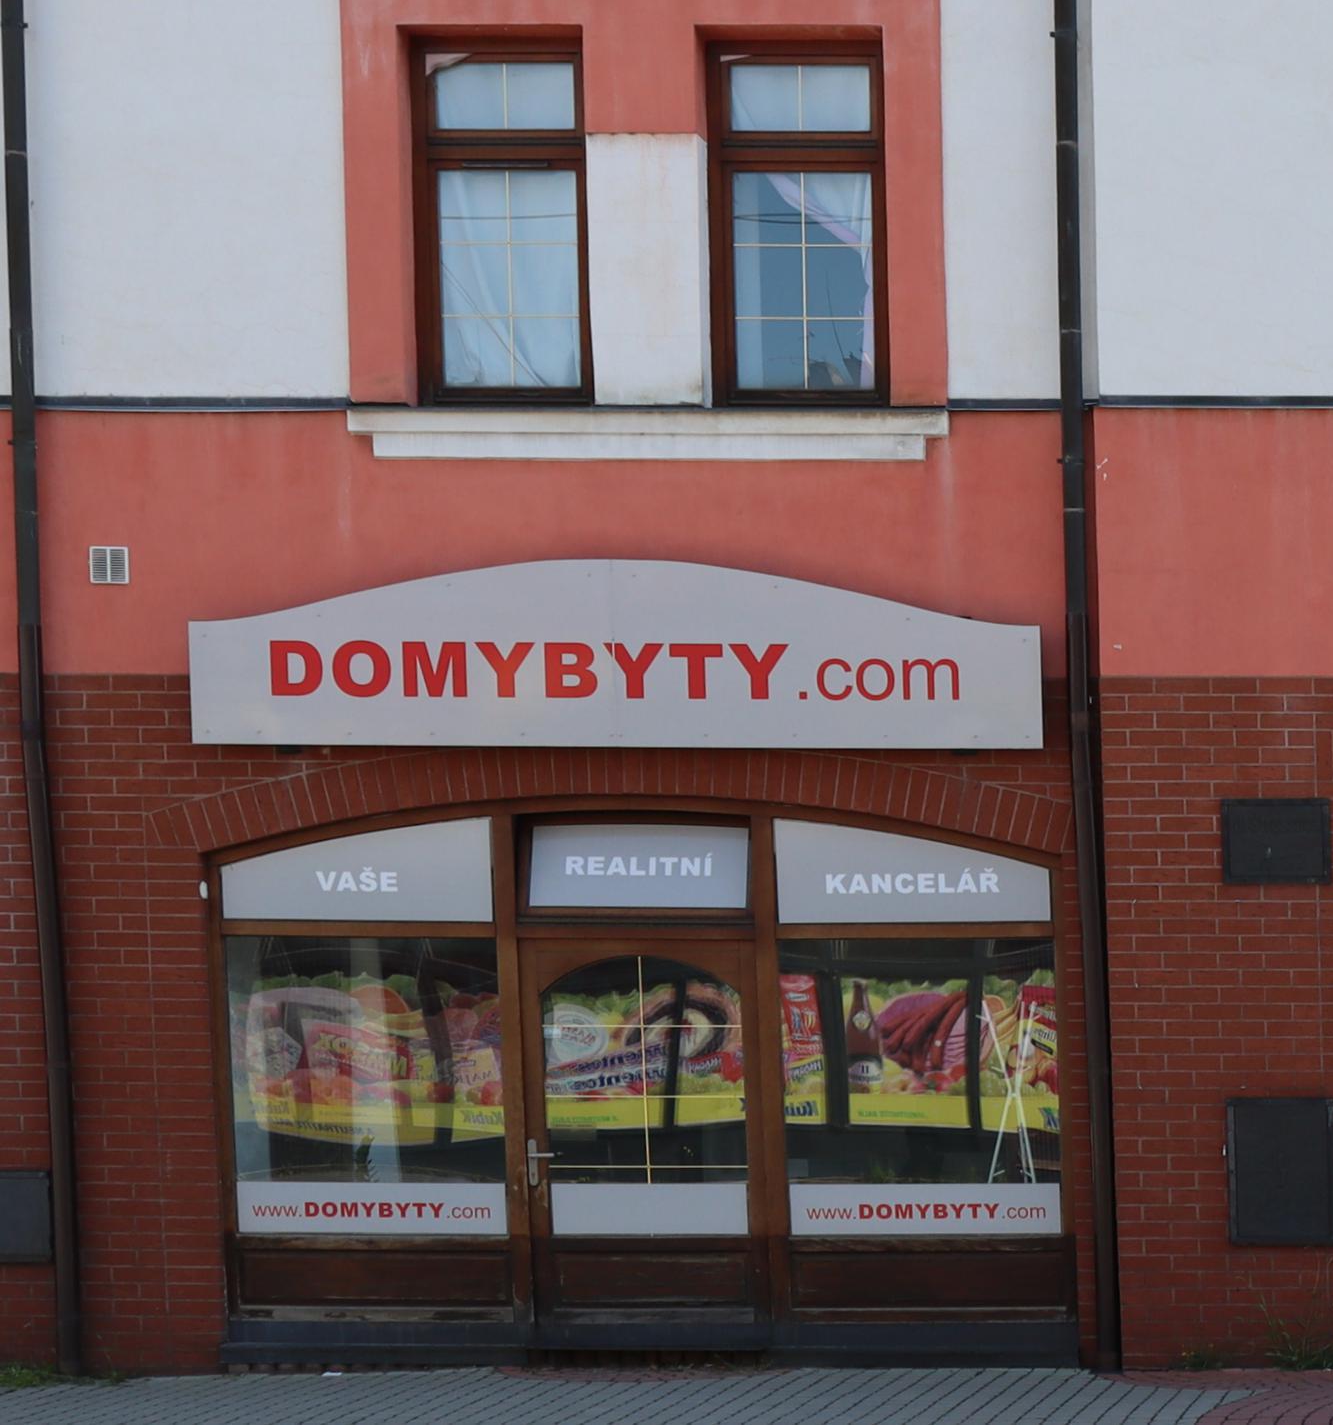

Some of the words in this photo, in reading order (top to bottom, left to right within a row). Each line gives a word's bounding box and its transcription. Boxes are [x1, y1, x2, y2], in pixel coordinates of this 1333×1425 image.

[269, 639, 960, 701] DOMYBYTY.com
[315, 868, 399, 893] VAŠE
[564, 853, 713, 878] REALITNÍ
[824, 866, 999, 895] KANCELÁŘ
[252, 1201, 491, 1219] www.DOMYBYTY.com
[806, 1203, 1046, 1220] www.DOMYBYTY.com
